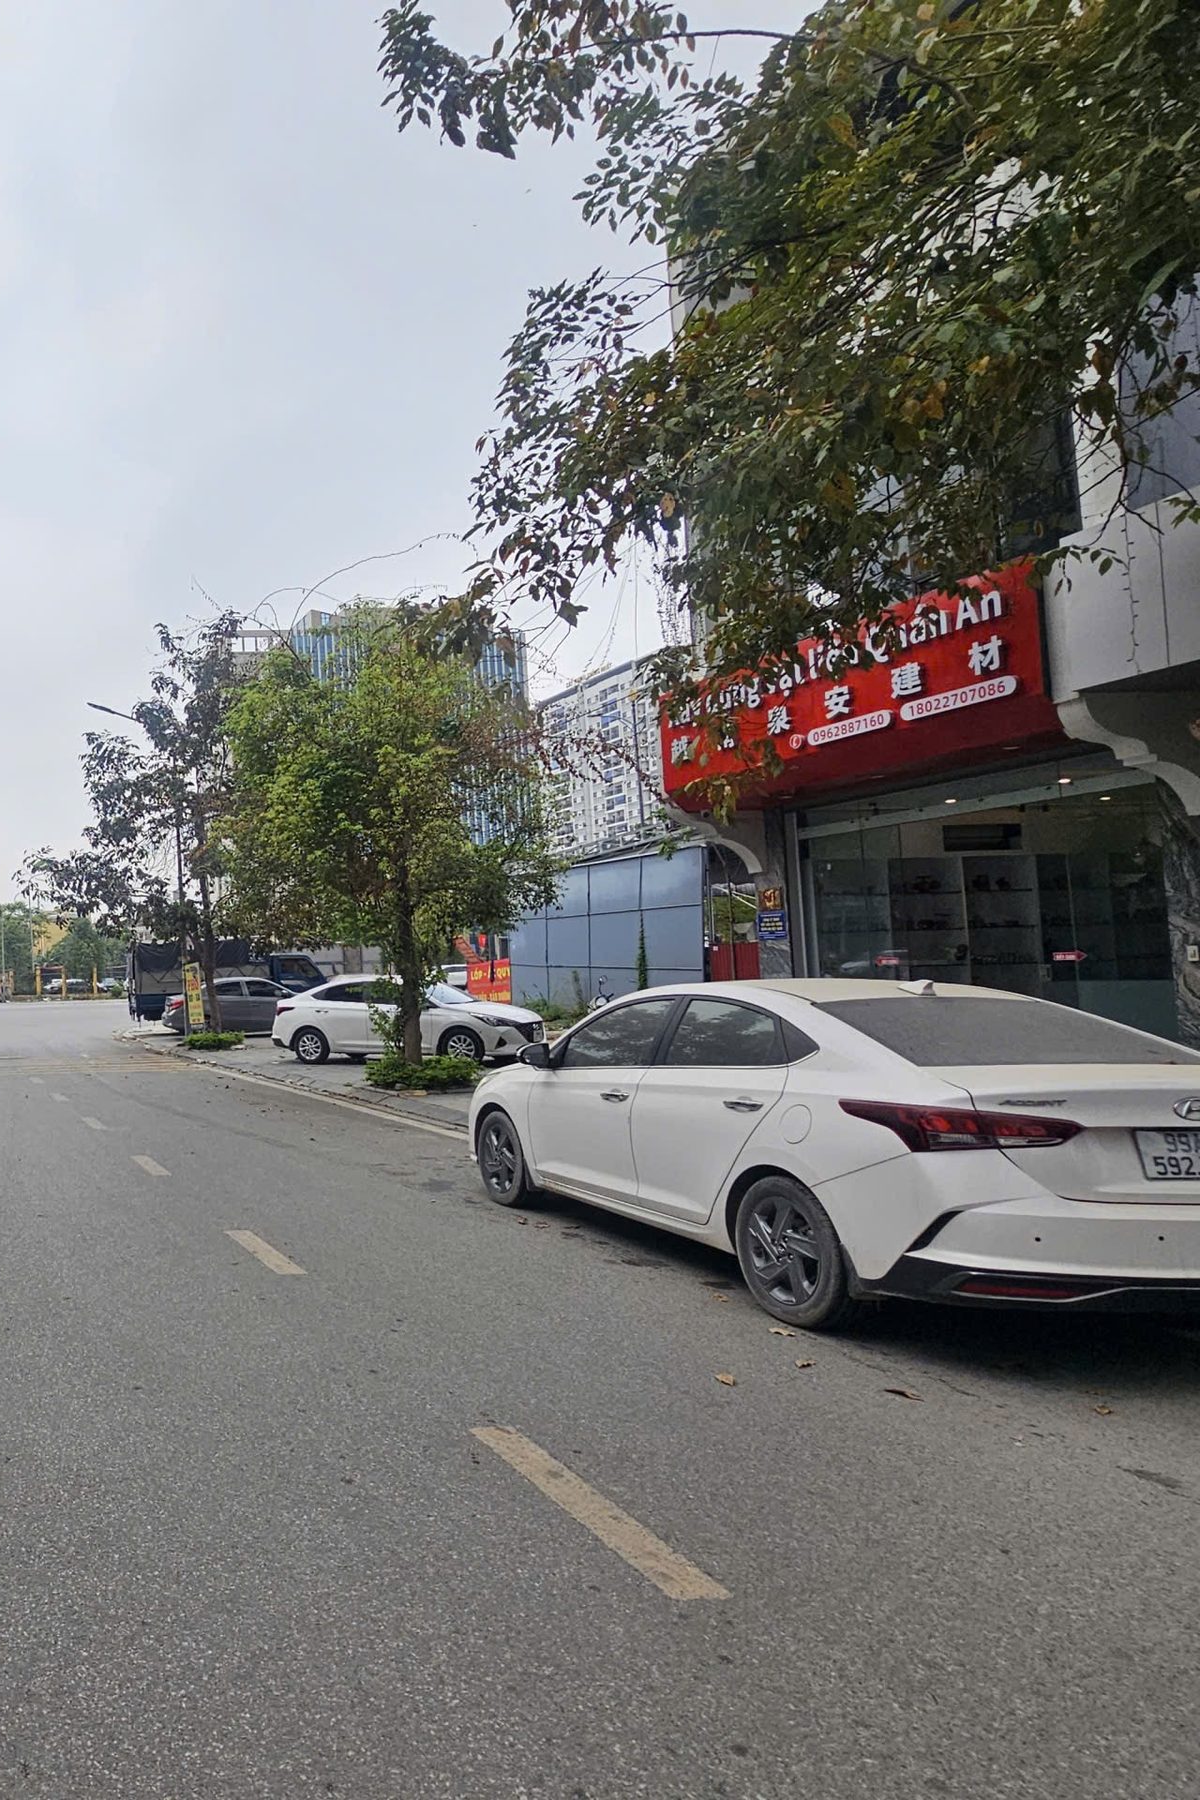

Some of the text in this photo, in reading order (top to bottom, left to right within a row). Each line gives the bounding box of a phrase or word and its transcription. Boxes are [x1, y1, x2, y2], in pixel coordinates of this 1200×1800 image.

[955, 590, 1002, 631] An
[813, 681, 1006, 743] 0962887160 18022707086
